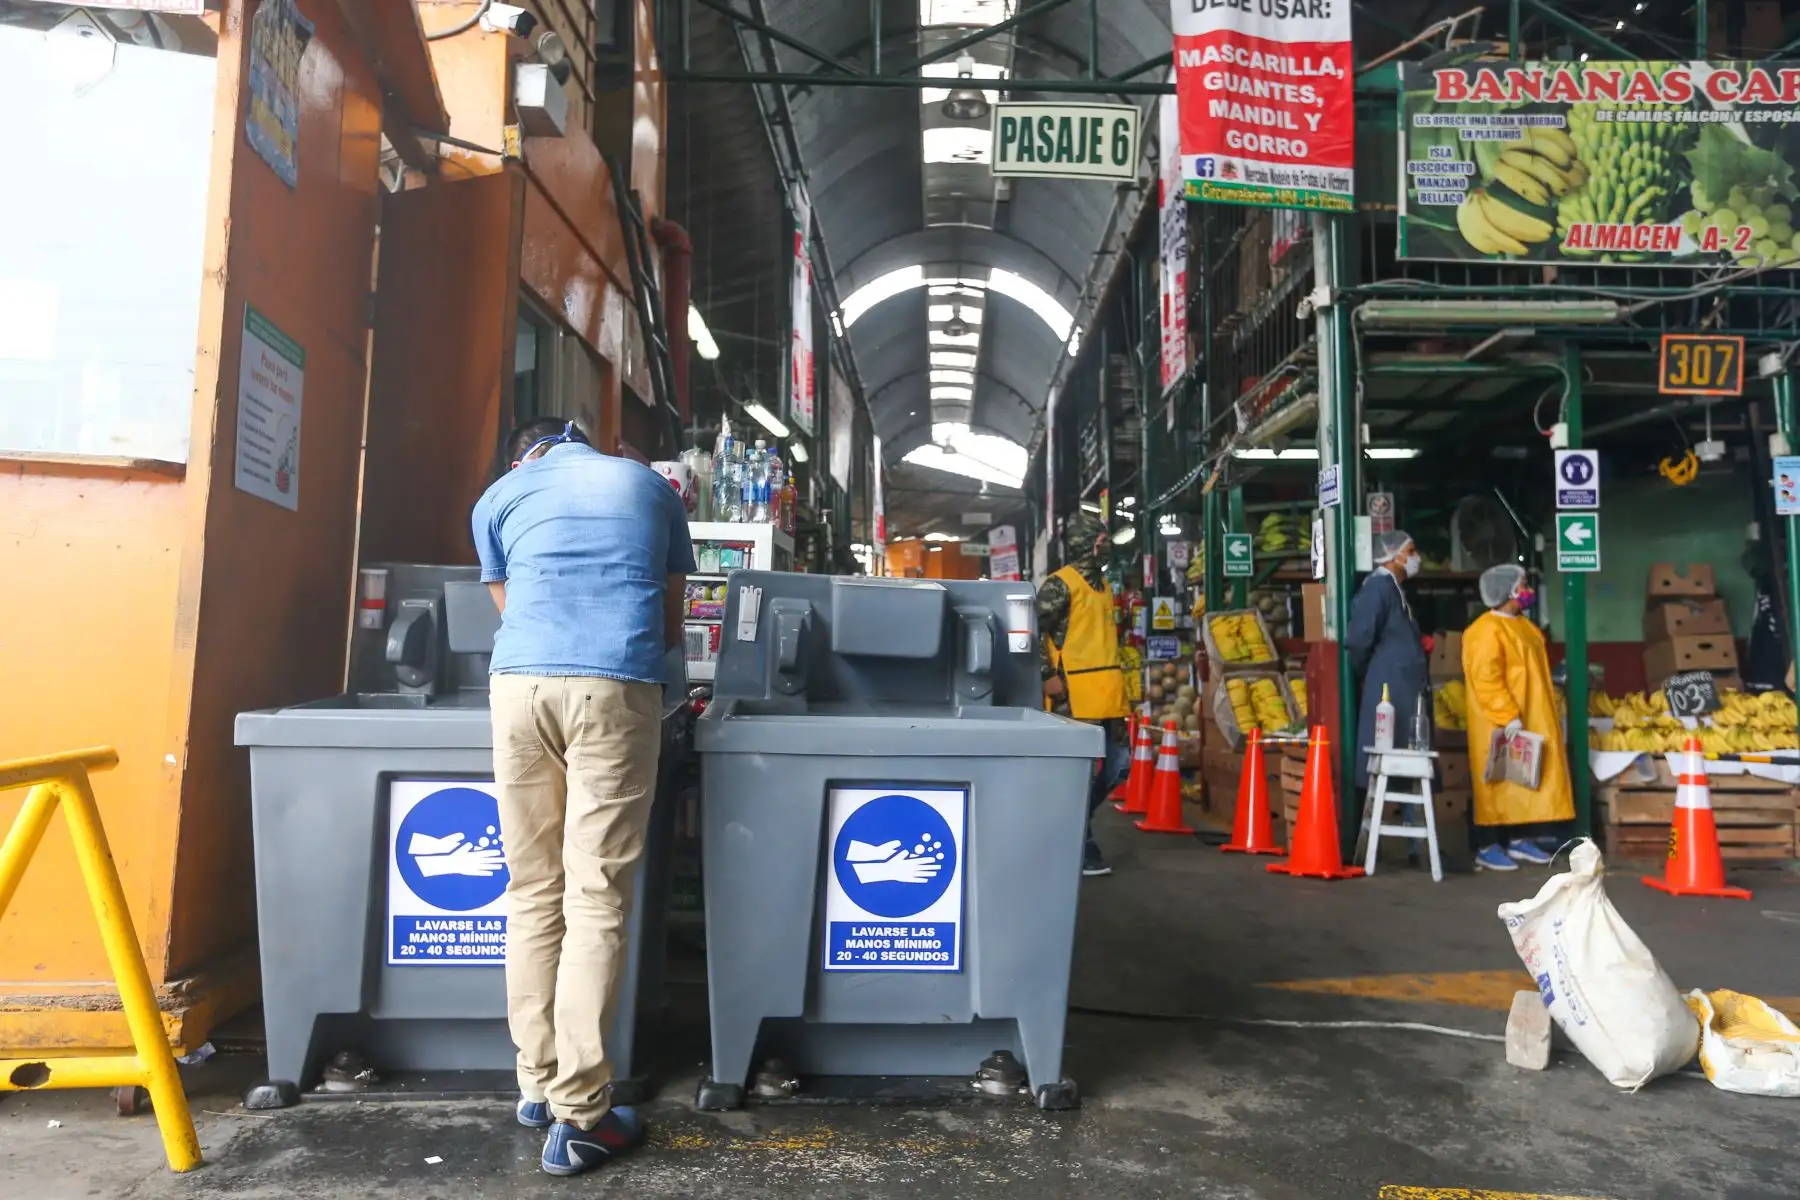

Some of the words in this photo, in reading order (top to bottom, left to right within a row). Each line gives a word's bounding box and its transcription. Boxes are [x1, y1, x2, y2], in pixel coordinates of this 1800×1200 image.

[1259, 0, 1331, 19] USAR:
[1179, 44, 1344, 79] MASCARILLA,
[1203, 72, 1324, 107] GUANTES,
[1434, 68, 1693, 102] BANANAS
[1208, 99, 1298, 130] MANDIL
[1304, 113, 1322, 131] Y
[1596, 111, 1614, 122] DE
[1616, 110, 1673, 122] CARLOS
[1675, 111, 1731, 123] FALCON
[1732, 111, 1742, 122] Y
[1415, 116, 1432, 126] LES
[1433, 116, 1467, 126] OFRECE
[1469, 116, 1487, 126] UNA
[1490, 116, 1516, 126] GRAN
[1518, 116, 1563, 126] VARIEDAD
[1461, 129, 1474, 139] EN
[1475, 129, 1521, 139] PLATANOS
[1000, 116, 1103, 164] PASAJE
[1112, 118, 1130, 166] 6
[1226, 130, 1308, 158] GORRO
[1429, 147, 1452, 158] ISLA
[1408, 162, 1474, 173] BISCOCHITO
[1416, 177, 1467, 188] MANZANO
[1420, 193, 1464, 204] BELLACO
[1566, 223, 1683, 251] ALMACEN
[1734, 225, 1752, 251] 2
[1669, 344, 1734, 386] 307
[415, 920, 474, 931] LAVARSE
[477, 920, 502, 931] LAS
[409, 932, 456, 943] MANOS
[459, 931, 507, 943] MÍNIMO
[852, 927, 908, 937] LAVARSE
[911, 927, 936, 937] LAS
[845, 939, 891, 949] MANOS
[894, 938, 941, 949] MÍNIMO
[400, 945, 416, 955] 20
[427, 945, 442, 955] 40
[446, 945, 506, 956] SEGUNDO
[836, 951, 852, 961] 20
[862, 951, 877, 961] 40
[880, 951, 949, 961] SEGUNDOS
